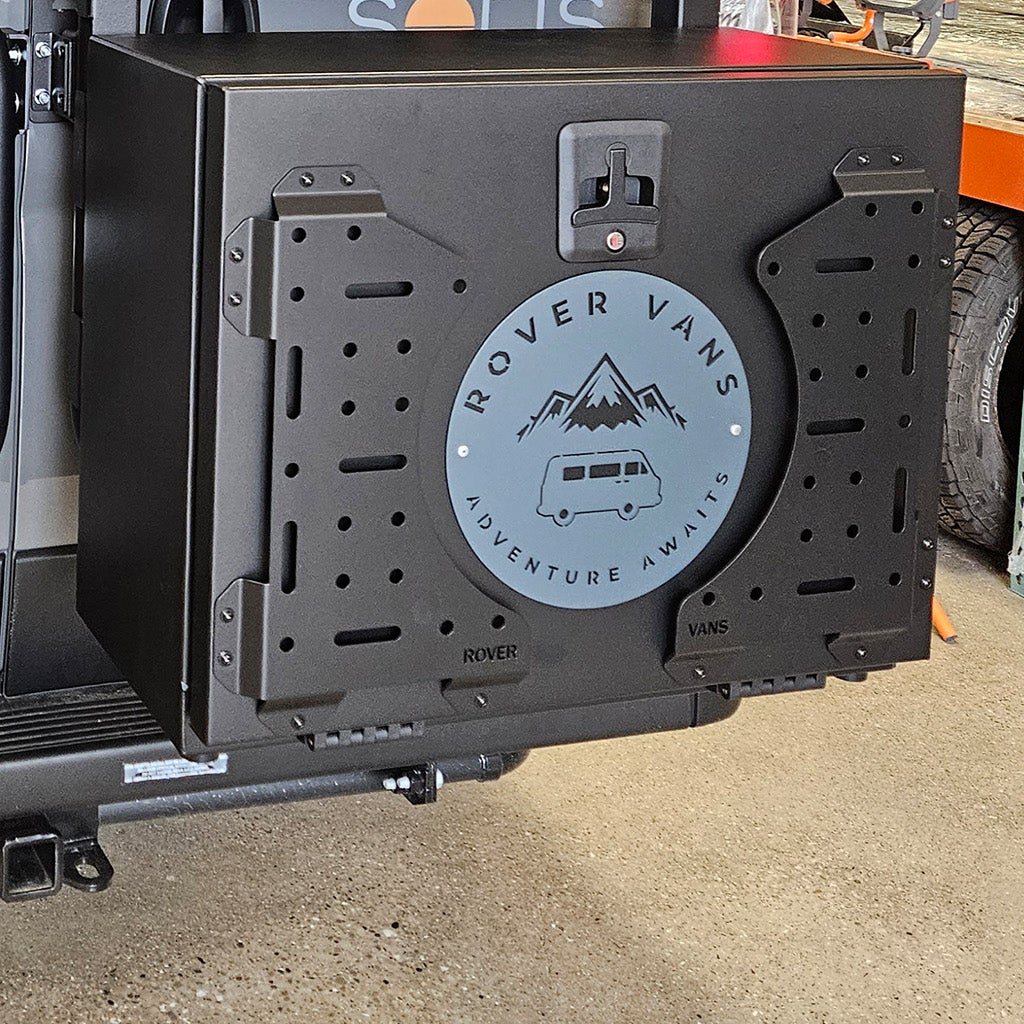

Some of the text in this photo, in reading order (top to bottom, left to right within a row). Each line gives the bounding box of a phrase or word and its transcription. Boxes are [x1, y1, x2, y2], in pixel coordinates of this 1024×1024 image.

[463, 291, 738, 414] ROVER VANS
[465, 471, 730, 585] ADVENTURE AWAITS
[462, 644, 518, 665] ROVER
[687, 619, 729, 638] VANS
